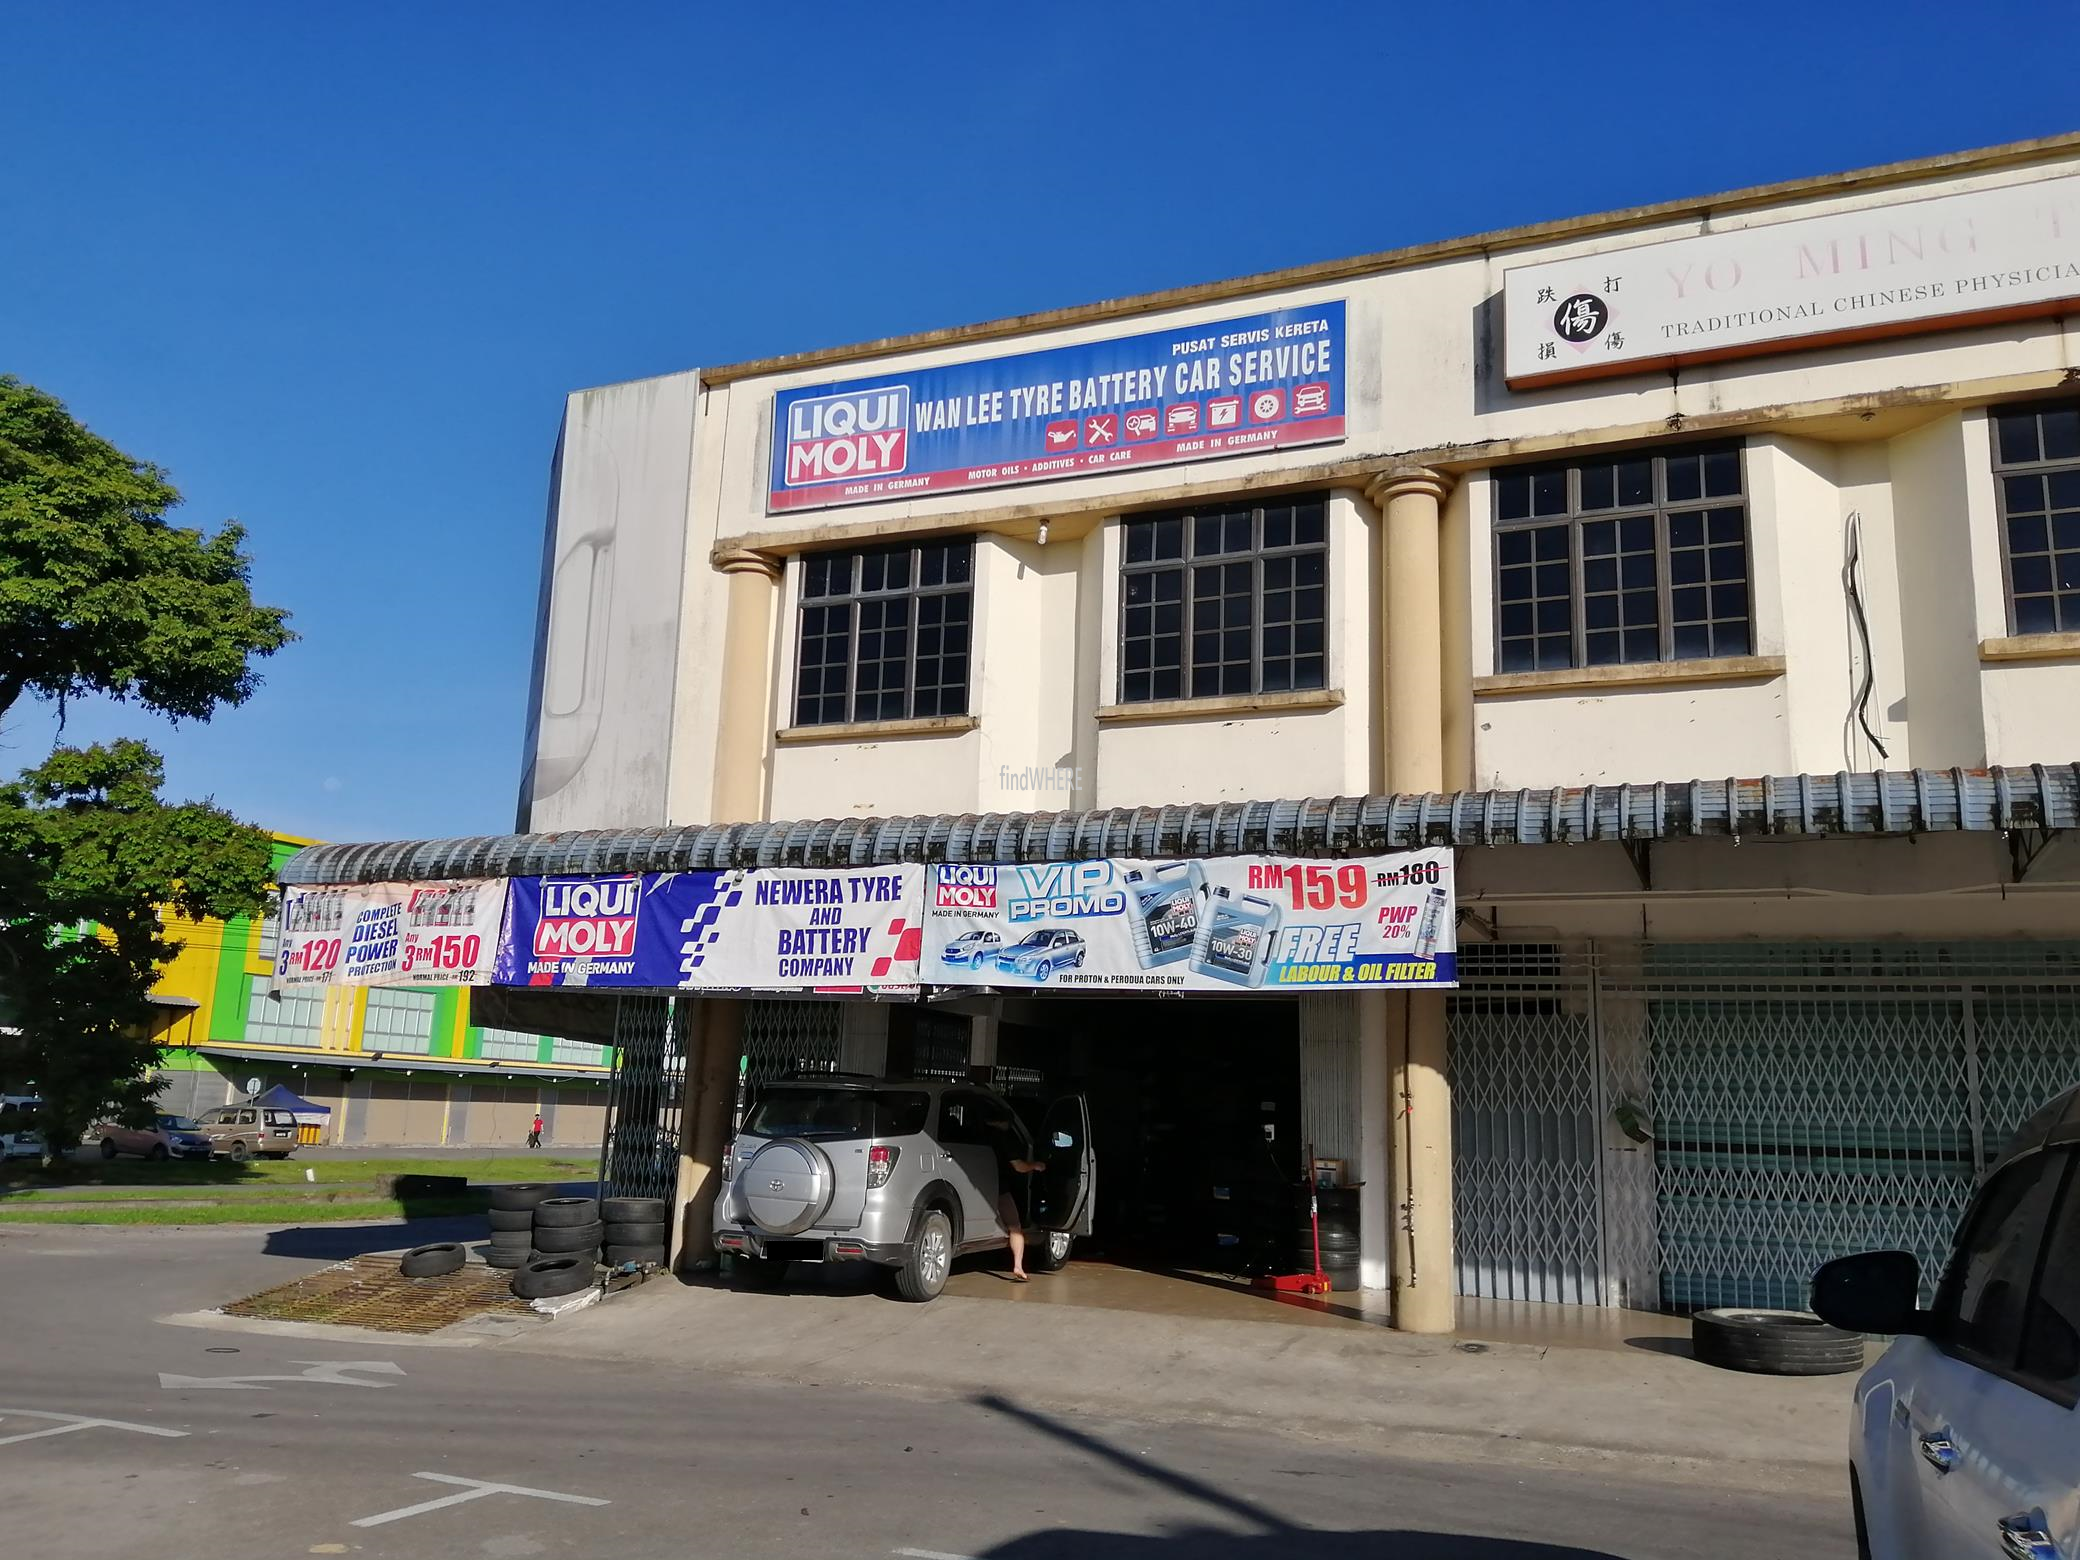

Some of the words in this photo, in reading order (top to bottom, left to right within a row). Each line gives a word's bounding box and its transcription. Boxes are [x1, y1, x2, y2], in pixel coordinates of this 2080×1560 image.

[1666, 258, 1743, 299] YO
[1795, 217, 1976, 280] MING
[1537, 286, 1557, 304] 跌
[1604, 276, 1622, 293] 打
[1560, 299, 1600, 336] 傷
[1661, 302, 1824, 338] TRADITIONAL
[1834, 282, 1945, 312] CHINESE
[1172, 338, 1216, 356] PUSAT
[1221, 328, 1269, 348] SERVIS
[1275, 319, 1329, 338] KERETA
[1605, 332, 1625, 350] 傷
[915, 397, 961, 432] WAN
[966, 391, 1003, 426] LEE
[1010, 382, 1063, 420] TYRE
[1069, 365, 1168, 411] BATTERY
[1175, 357, 1220, 395] CAR
[1229, 339, 1330, 386] SERVICE
[794, 394, 899, 440] LIQUI
[1176, 441, 1204, 453] MADE
[1211, 439, 1222, 447] IN
[1227, 430, 1278, 446] GERMANY
[791, 432, 901, 479] MOLY
[968, 468, 997, 480] MOTOR
[1002, 465, 1019, 475] OILS
[1032, 458, 1074, 472] ADDITIVES
[1088, 454, 1105, 464] CAR
[1110, 450, 1131, 462] CARE
[845, 484, 868, 495] MADE
[874, 483, 883, 492] IN
[888, 476, 930, 490] GERMANY
[940, 866, 995, 886] LIQUI
[1018, 860, 1112, 898] VIP
[1248, 864, 1368, 911] RM159
[545, 883, 635, 918] LIQUI
[755, 879, 844, 906] NEWERA
[848, 875, 903, 903] TYRE
[939, 886, 995, 906] MOLY
[356, 902, 402, 923] COMPLETE
[809, 907, 842, 926] AND
[963, 911, 1000, 919] GERMANY
[1010, 892, 1124, 920] PROMO
[1172, 902, 1192, 913] MOLY
[1377, 906, 1418, 924] PWP
[352, 917, 398, 943] DIESEL
[405, 932, 419, 943] Any
[538, 920, 634, 953] MOLY
[1150, 915, 1197, 938] 10W-40
[1383, 925, 1411, 938] 20%
[345, 938, 399, 964] POWER
[777, 927, 871, 955] BATTERY
[1211, 940, 1253, 961] 10W-30
[1277, 923, 1361, 963] FREE
[347, 959, 397, 977] PROTECTION
[527, 961, 559, 974] MADE
[561, 962, 576, 973] IN
[578, 961, 635, 974] GERMANY
[778, 957, 854, 977] COMPANY
[1279, 965, 1341, 982] LABOUR
[1342, 967, 1355, 980] &
[1358, 964, 1384, 980] OIL
[1385, 962, 1437, 980] FILTER
[1059, 974, 1072, 983] FOR
[1074, 974, 1102, 983] PROTON
[1111, 975, 1144, 984] PERODUA
[1145, 975, 1165, 985] CARS
[1167, 976, 1185, 985] ONLY
